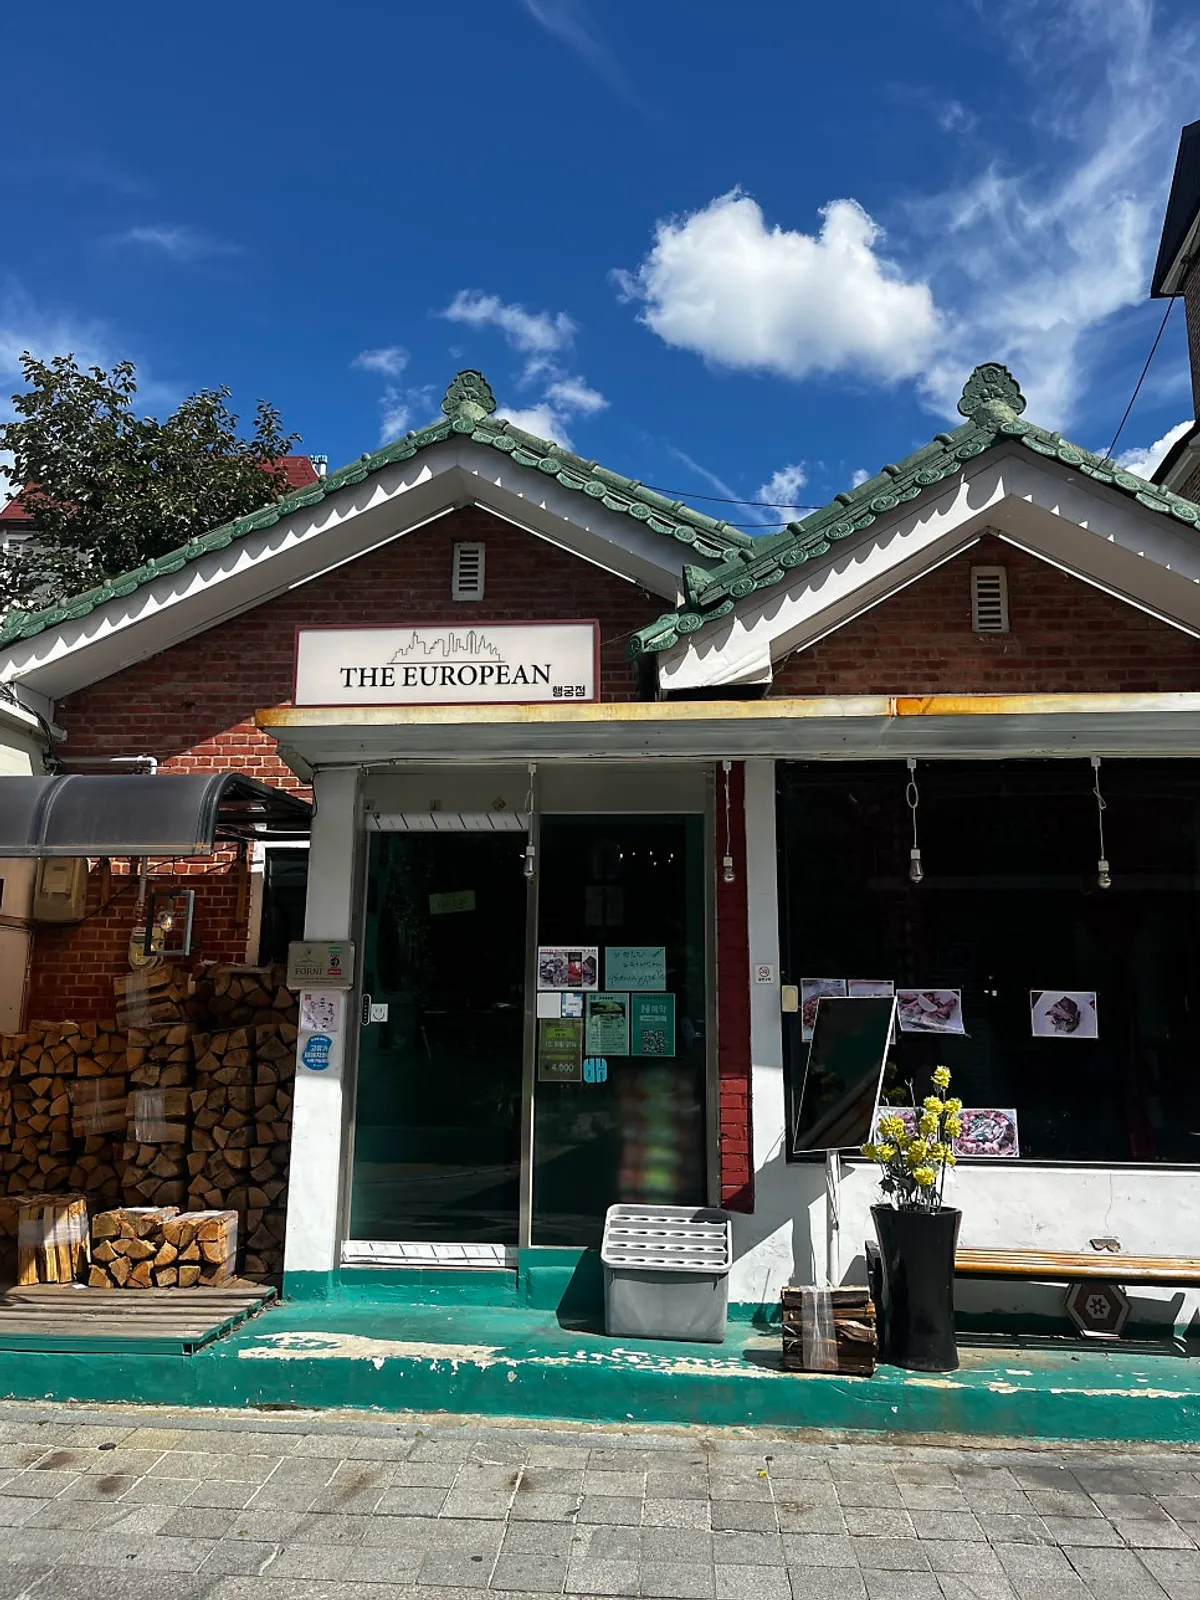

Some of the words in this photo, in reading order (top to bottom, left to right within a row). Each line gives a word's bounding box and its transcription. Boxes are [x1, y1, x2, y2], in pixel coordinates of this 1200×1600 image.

[340, 667, 395, 688] THE
[401, 664, 552, 687] EUROPEAN
[552, 685, 586, 698] 행궁점
[295, 967, 322, 975] FORNI
